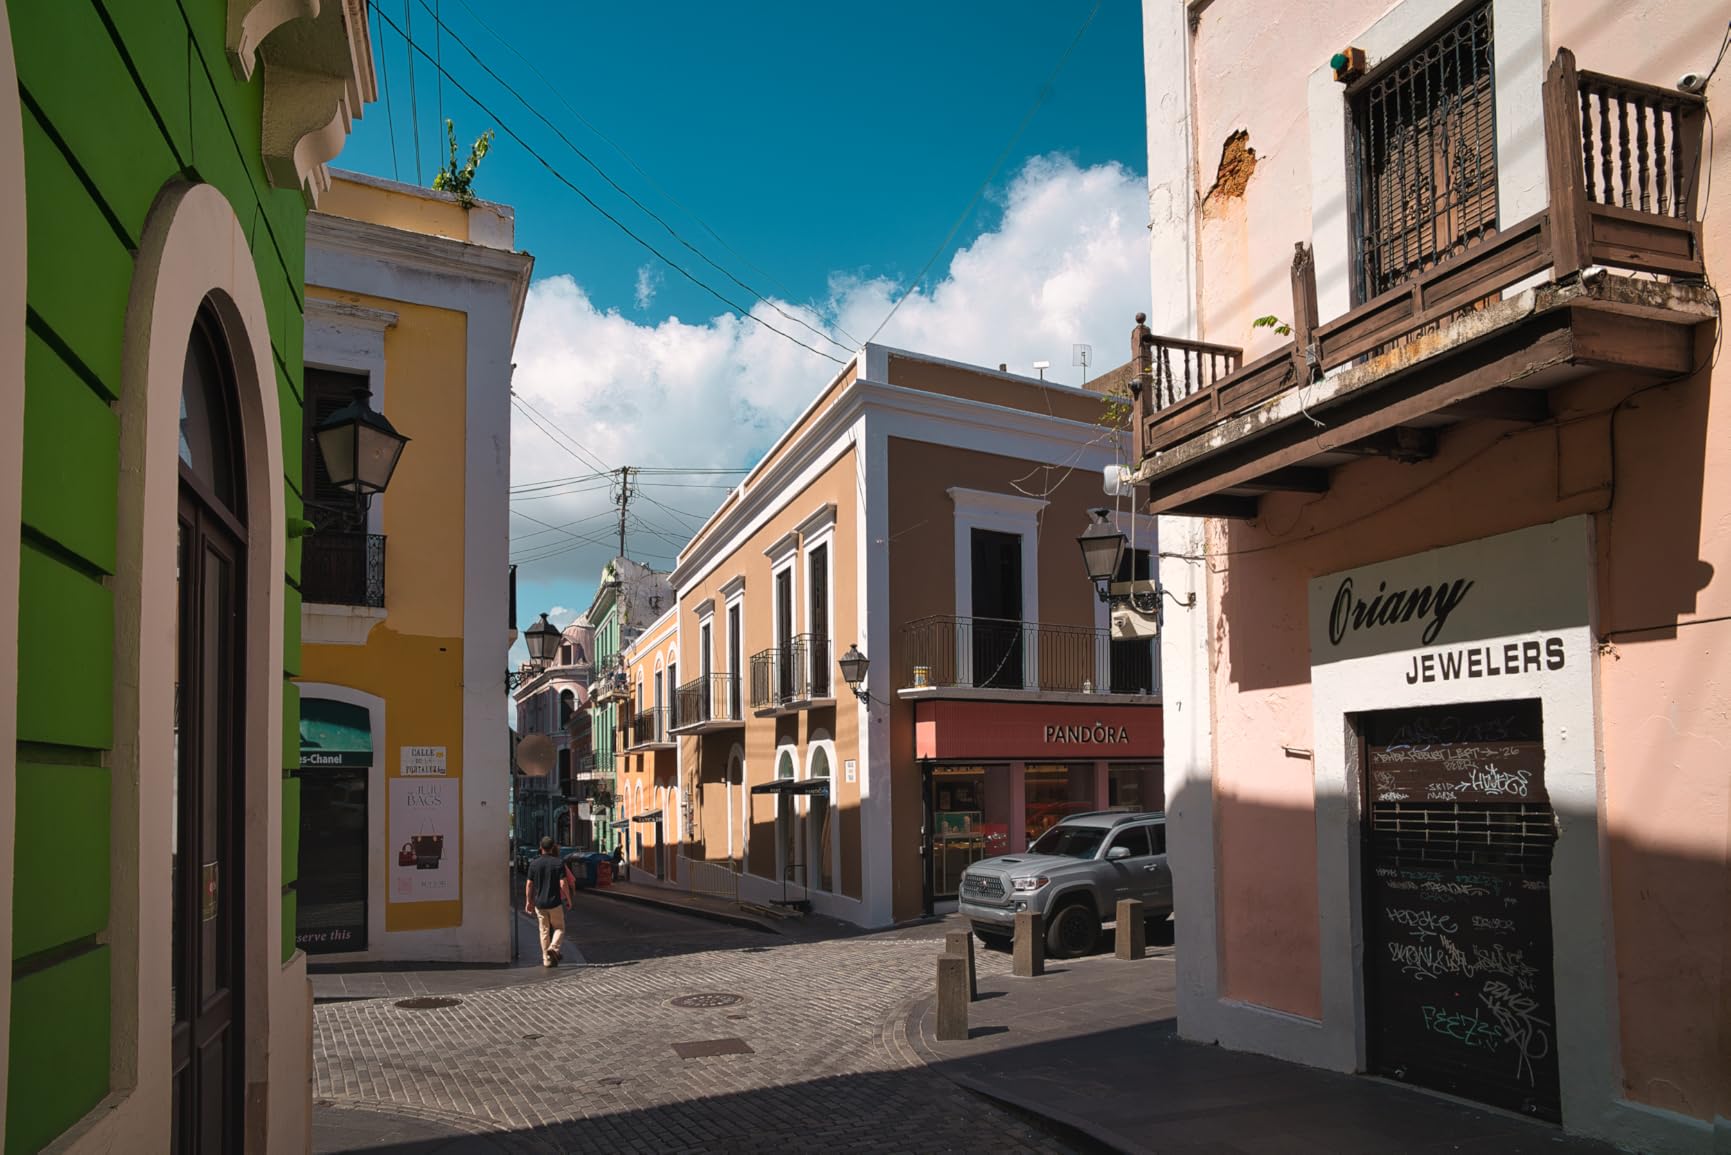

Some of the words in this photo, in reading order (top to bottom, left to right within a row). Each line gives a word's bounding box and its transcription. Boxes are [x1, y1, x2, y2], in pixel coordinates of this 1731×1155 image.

[1328, 577, 1475, 646] Oriany
[1405, 636, 1566, 685] JEWELERS
[411, 748, 435, 757] CALLE
[407, 795, 442, 807] BAGS
[296, 932, 327, 943] serve
[330, 929, 352, 941] this
